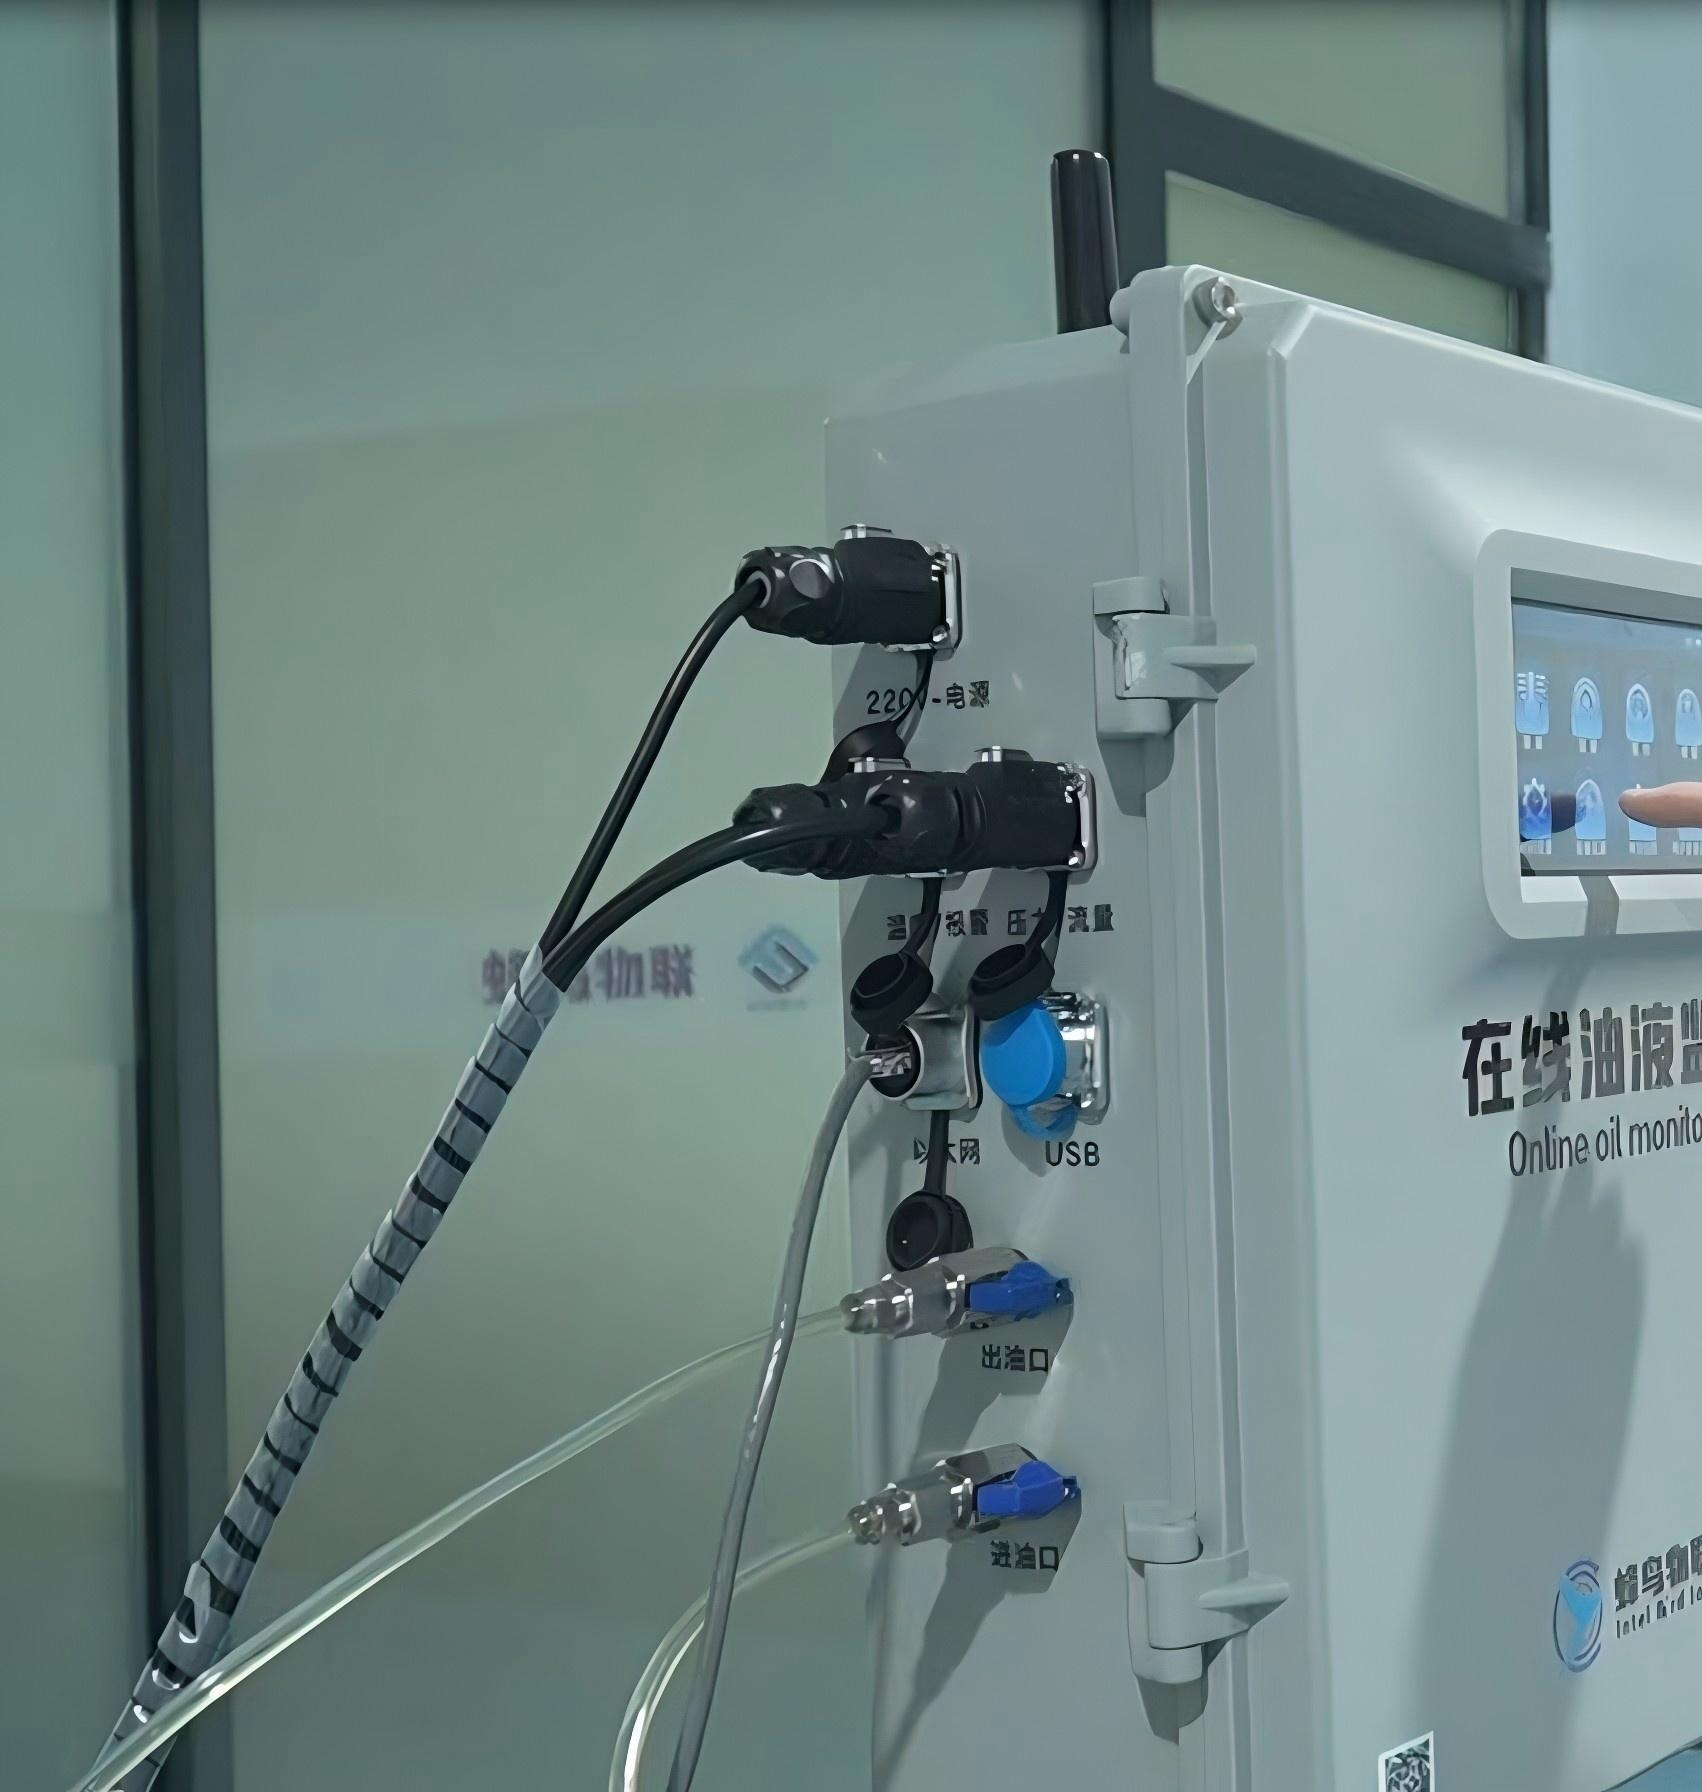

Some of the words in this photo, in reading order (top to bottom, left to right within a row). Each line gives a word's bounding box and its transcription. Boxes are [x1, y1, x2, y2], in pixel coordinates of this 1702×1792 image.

[1045, 1140, 1101, 1167] USB
[1508, 1124, 1590, 1176] Online
[1595, 1114, 1622, 1162] oil
